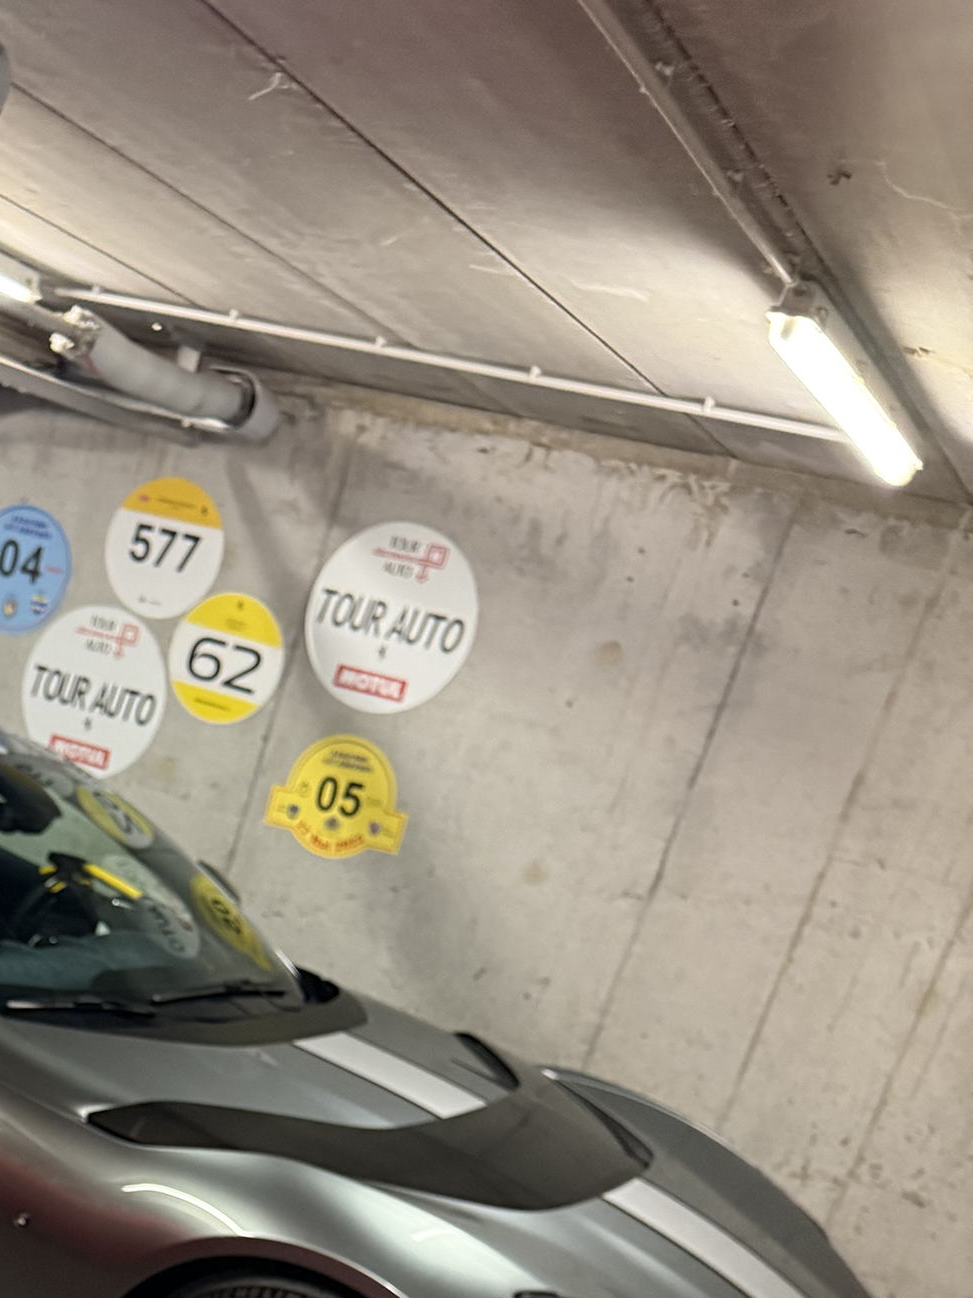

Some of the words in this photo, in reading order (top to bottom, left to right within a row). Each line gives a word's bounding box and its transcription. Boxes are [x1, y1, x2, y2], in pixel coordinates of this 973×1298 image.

[128, 523, 201, 573] 577
[316, 588, 387, 638] TOUR
[385, 606, 465, 653] AUTO
[187, 637, 261, 695] 62
[30, 664, 91, 712] TOUR
[89, 682, 157, 727] AUTO
[316, 776, 364, 818] 05
